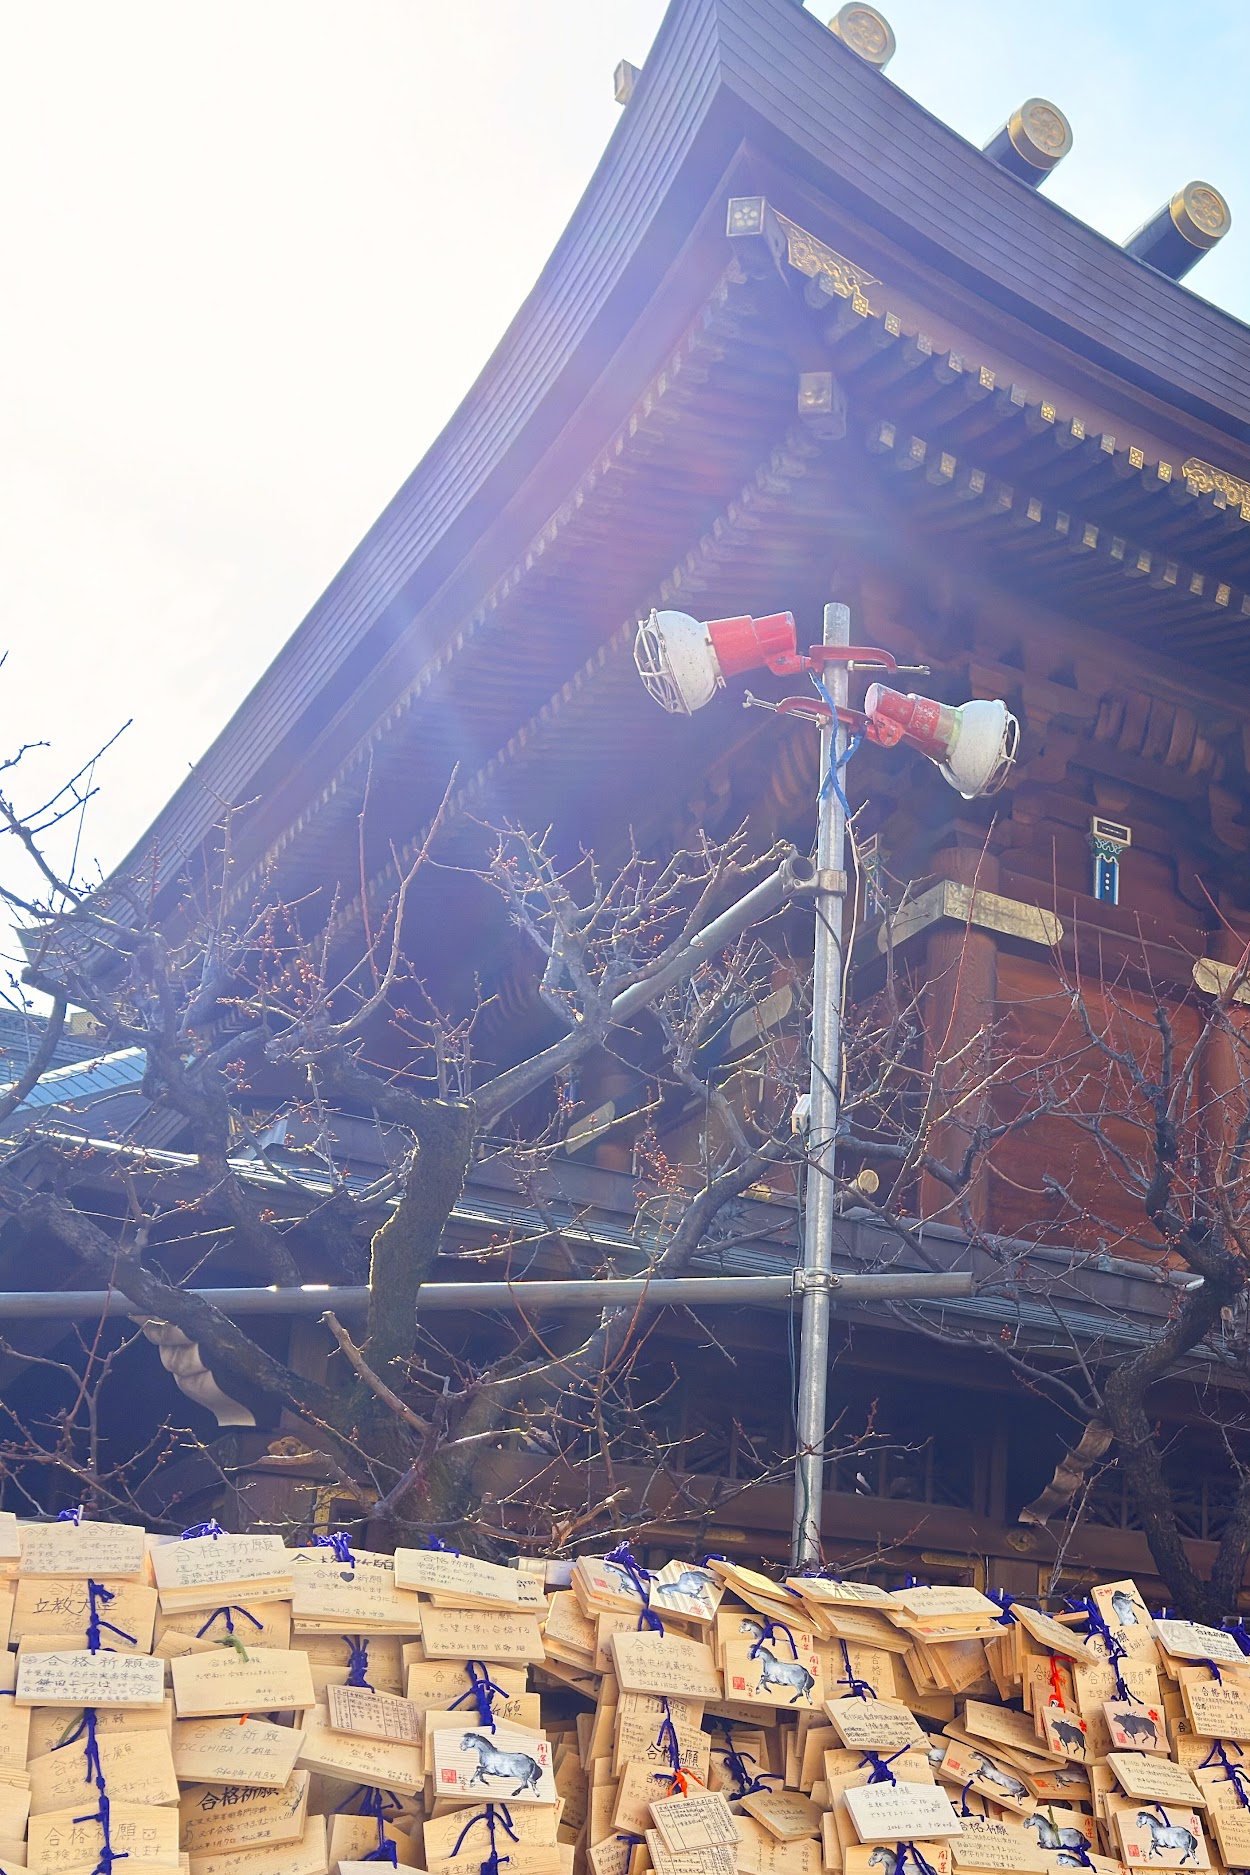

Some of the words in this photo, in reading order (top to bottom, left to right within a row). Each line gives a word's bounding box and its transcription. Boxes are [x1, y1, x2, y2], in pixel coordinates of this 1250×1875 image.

[167, 1538, 279, 1562] 合格祈願
[47, 1582, 128, 1600] 合格願
[32, 1597, 118, 1616] 立教大学
[41, 1655, 146, 1670] 合格祈願
[809, 1655, 820, 1677] 開運
[1088, 1669, 1145, 1686] 合格願
[1201, 1686, 1241, 1699] 合格祈願
[51, 1713, 126, 1731] 合祈願
[192, 1724, 282, 1742] 合格祈願
[537, 1743, 549, 1766] 開運
[195, 1785, 279, 1811] 合格祈願
[861, 1787, 912, 1799] 合格祈願
[45, 1822, 137, 1847] 合格祈願
[959, 1821, 1009, 1836] 合格祈願
[1190, 1815, 1201, 1837] 開運
[938, 1850, 949, 1874] 開運
